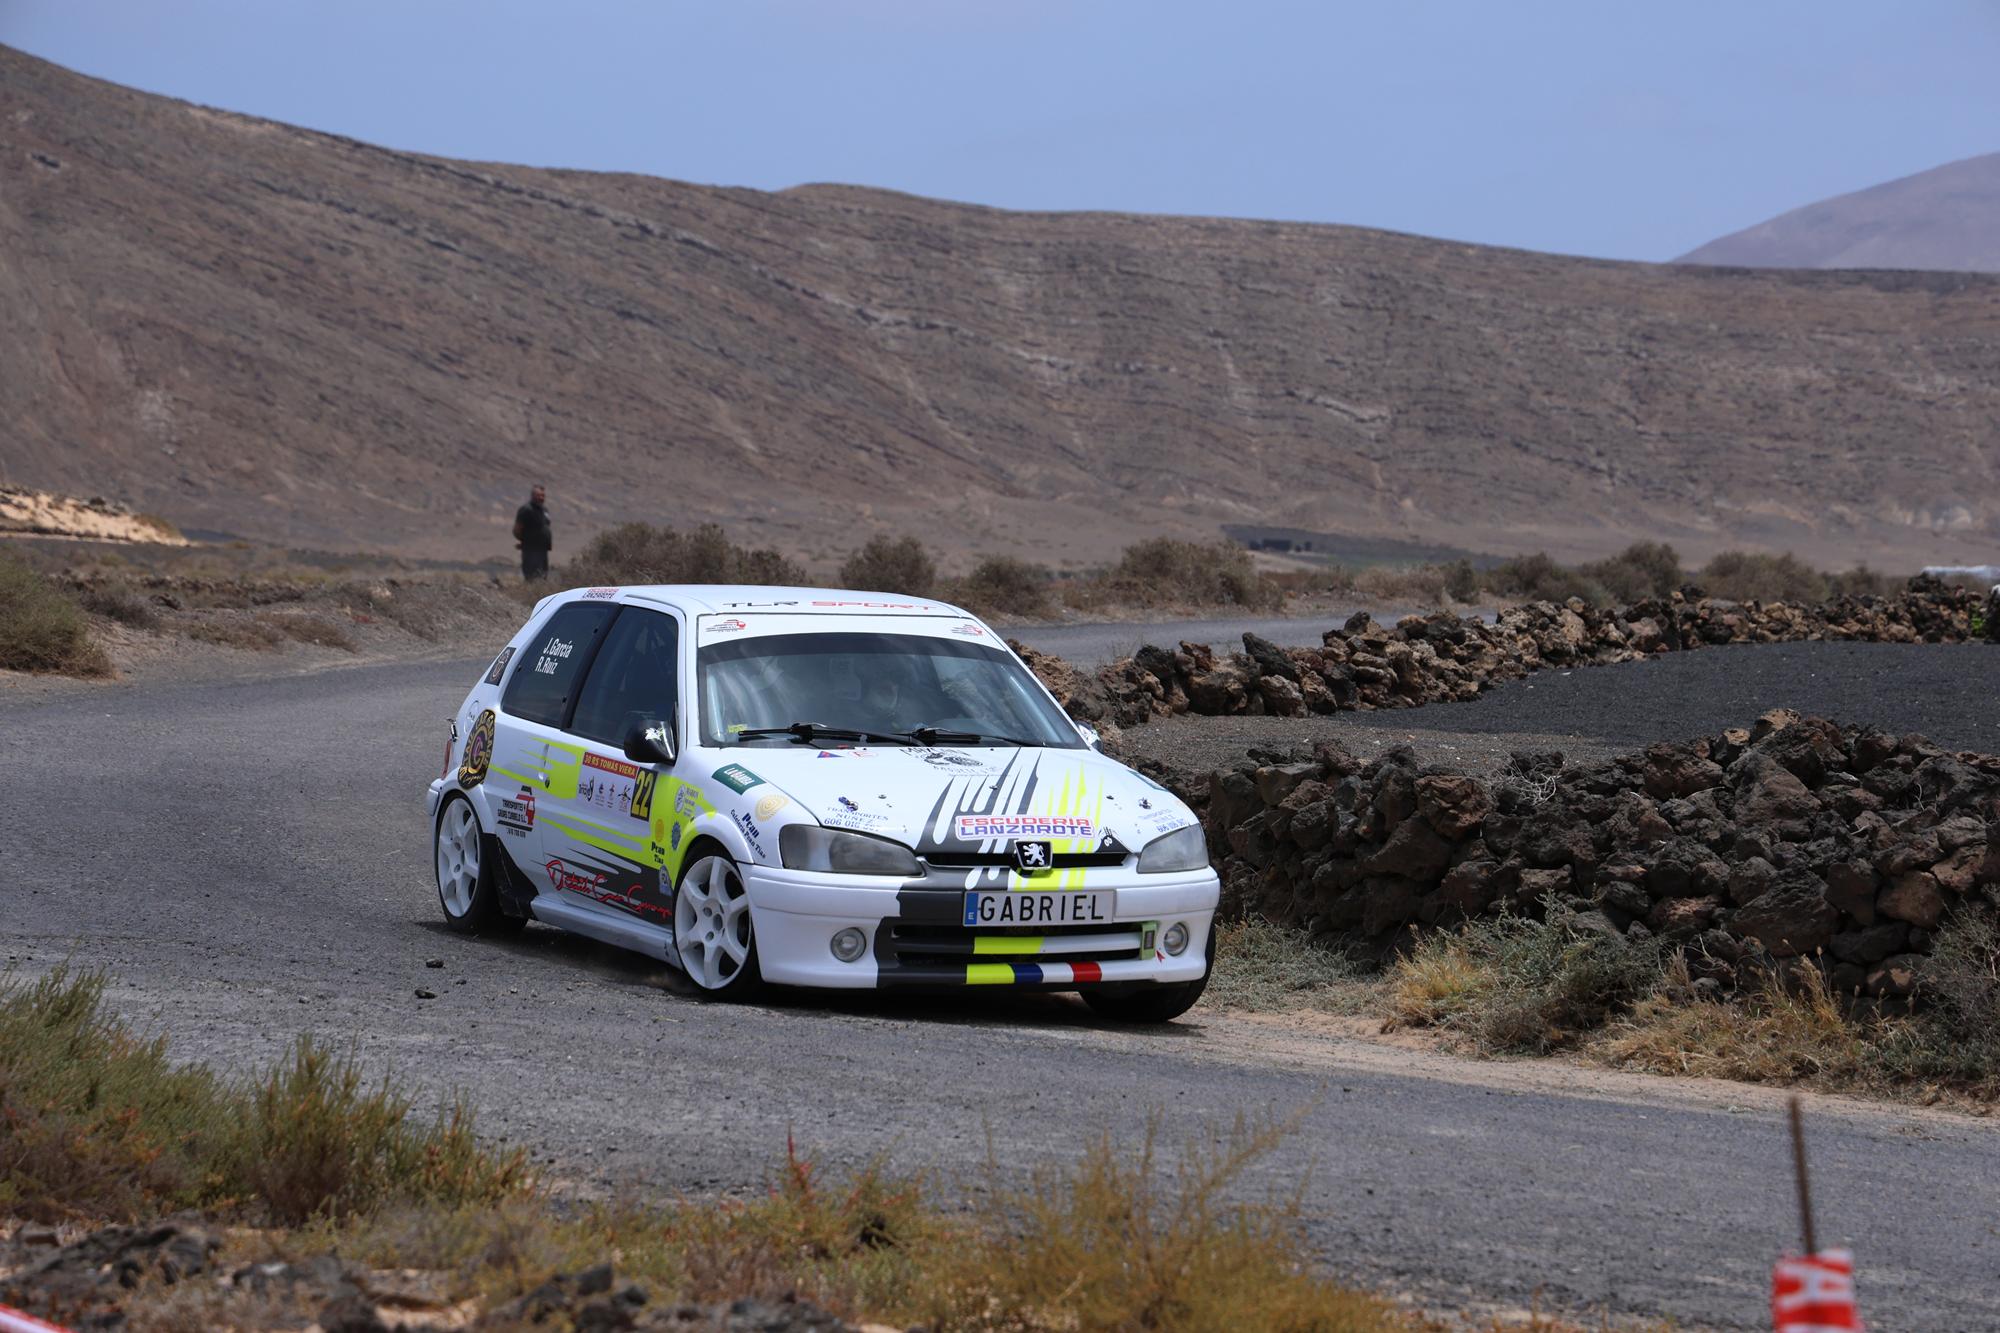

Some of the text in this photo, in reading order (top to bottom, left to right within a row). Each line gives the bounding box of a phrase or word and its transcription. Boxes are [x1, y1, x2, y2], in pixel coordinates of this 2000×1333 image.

[811, 601, 937, 611] SPORT
[619, 763, 636, 777] VIERA
[631, 770, 654, 818] 22
[961, 817, 1090, 827] ESCUDERIA
[960, 824, 1092, 836] LANZAROTE
[968, 895, 1104, 921] E GABRIEL
